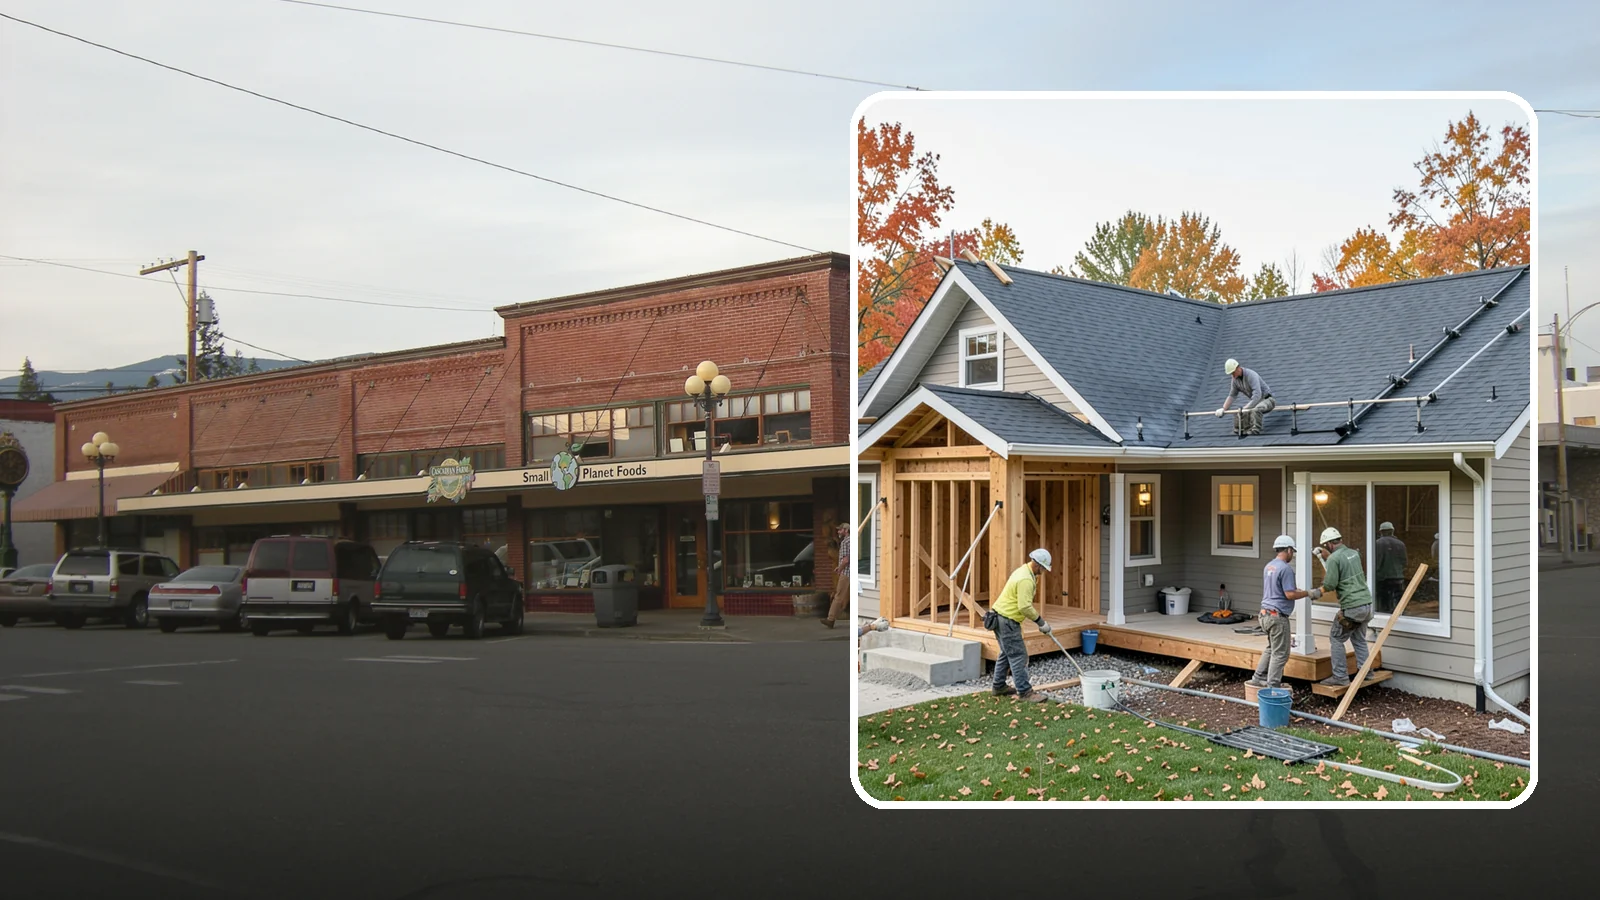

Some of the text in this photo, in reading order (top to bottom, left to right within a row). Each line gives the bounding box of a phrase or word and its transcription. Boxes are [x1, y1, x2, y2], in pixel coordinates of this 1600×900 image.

[523, 464, 647, 483] Small Planet Foods
